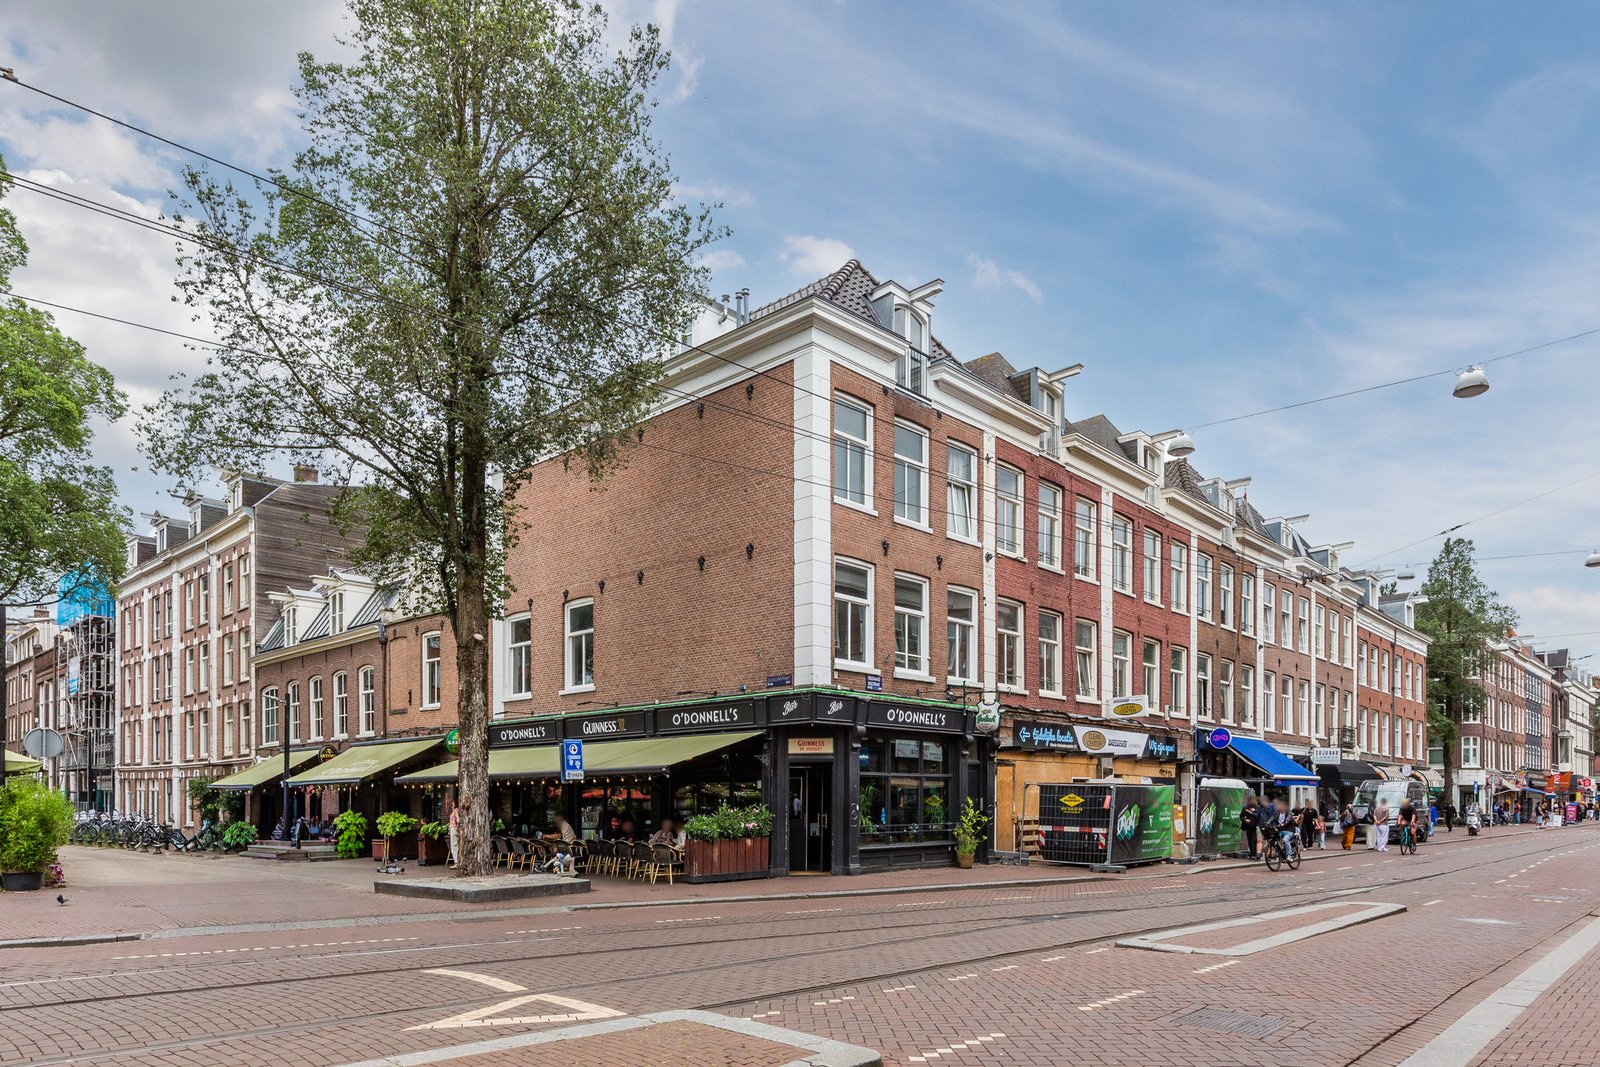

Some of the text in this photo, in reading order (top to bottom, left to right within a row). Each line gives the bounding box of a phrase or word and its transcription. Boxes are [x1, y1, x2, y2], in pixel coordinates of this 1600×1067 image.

[782, 700, 798, 716] Bar
[828, 700, 843, 715] Bar
[672, 708, 738, 726] O'DONNELL'S
[887, 708, 946, 726] O'DONNELL'S
[500, 726, 546, 740] O'DONNELL'S
[582, 720, 617, 734] GUINNESS
